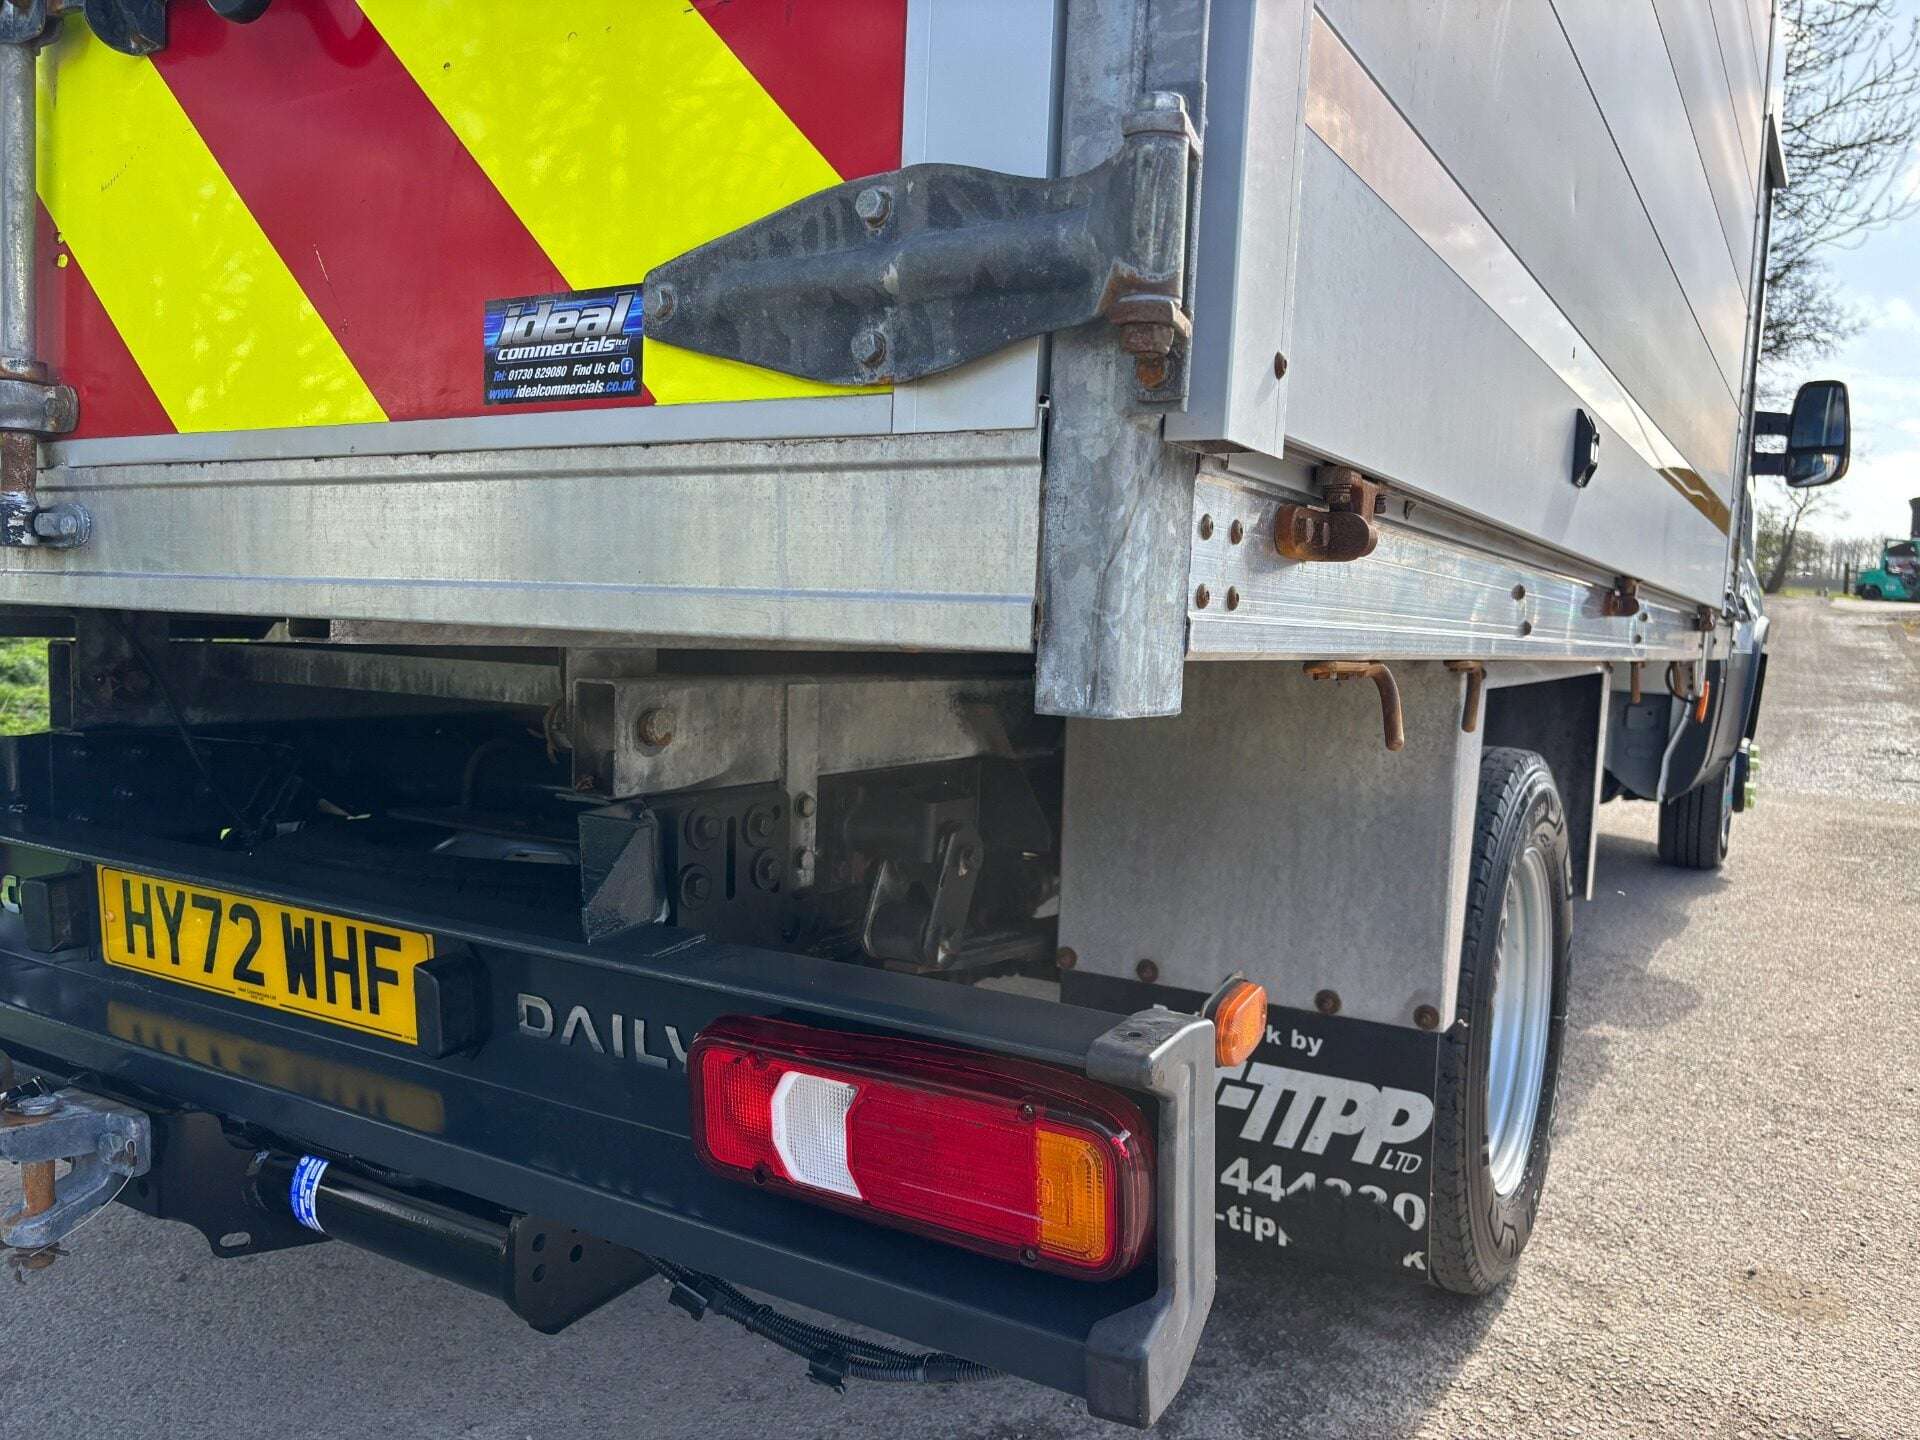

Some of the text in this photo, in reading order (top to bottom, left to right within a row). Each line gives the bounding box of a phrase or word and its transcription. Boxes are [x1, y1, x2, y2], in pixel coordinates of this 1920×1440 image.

[497, 291, 636, 345] ideal
[498, 336, 616, 360] commercials
[494, 370, 507, 382] Tel:
[508, 368, 533, 381] 01730
[534, 366, 567, 379] 829080
[573, 363, 593, 376] Find
[594, 363, 606, 375] Us
[607, 361, 620, 373] On
[489, 377, 636, 399] www.idealcommercials.co.uk
[122, 878, 402, 1015] HY72 WHF
[1291, 1029, 1323, 1057] by
[1379, 1149, 1423, 1174] LTD
